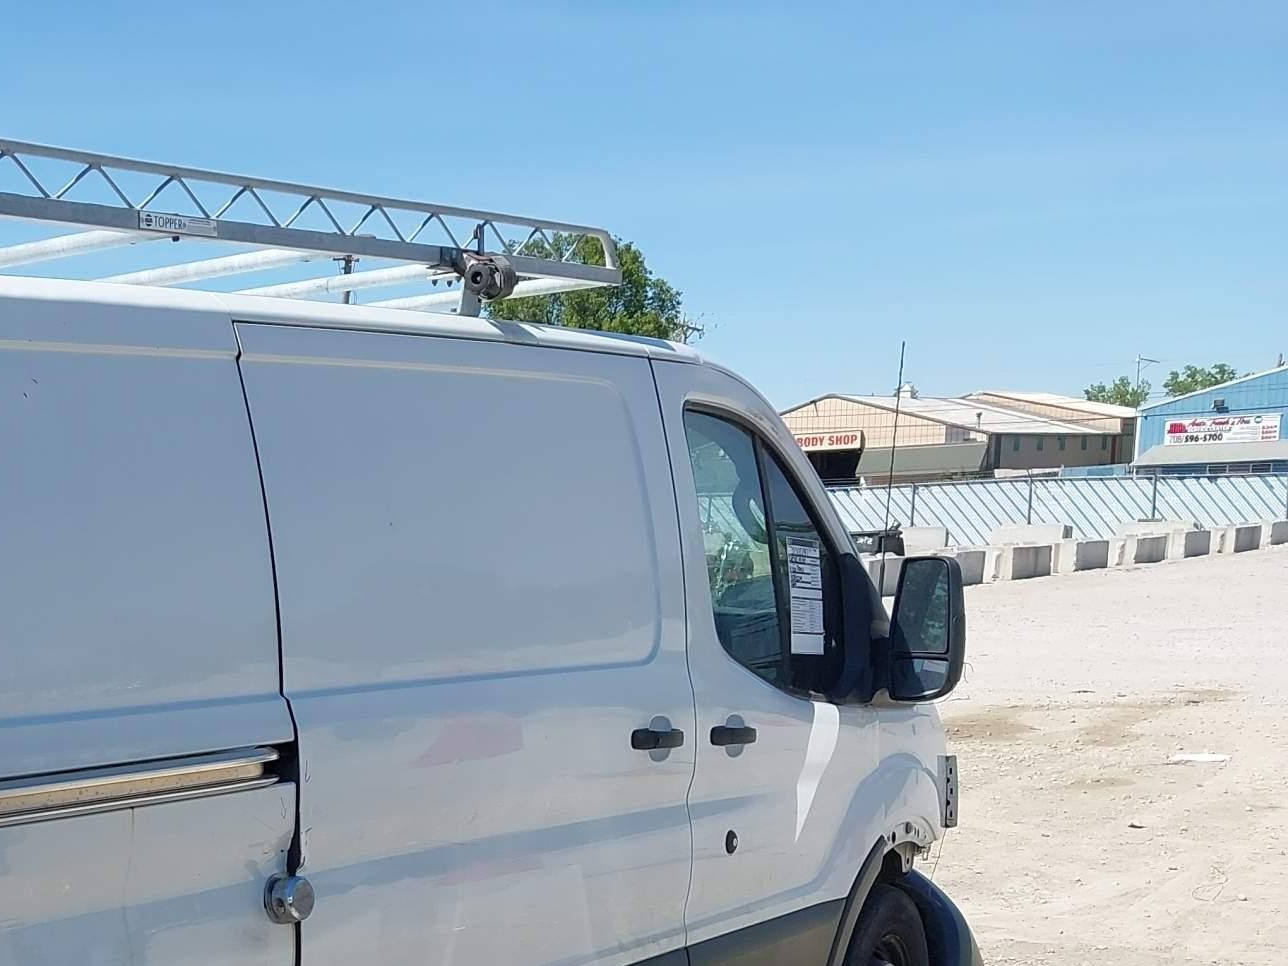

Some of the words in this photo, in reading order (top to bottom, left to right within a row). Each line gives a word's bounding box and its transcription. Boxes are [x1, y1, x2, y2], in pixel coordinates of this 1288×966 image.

[154, 215, 183, 230] TOPPER
[797, 436, 825, 447] BODY
[828, 434, 858, 446] SHOP
